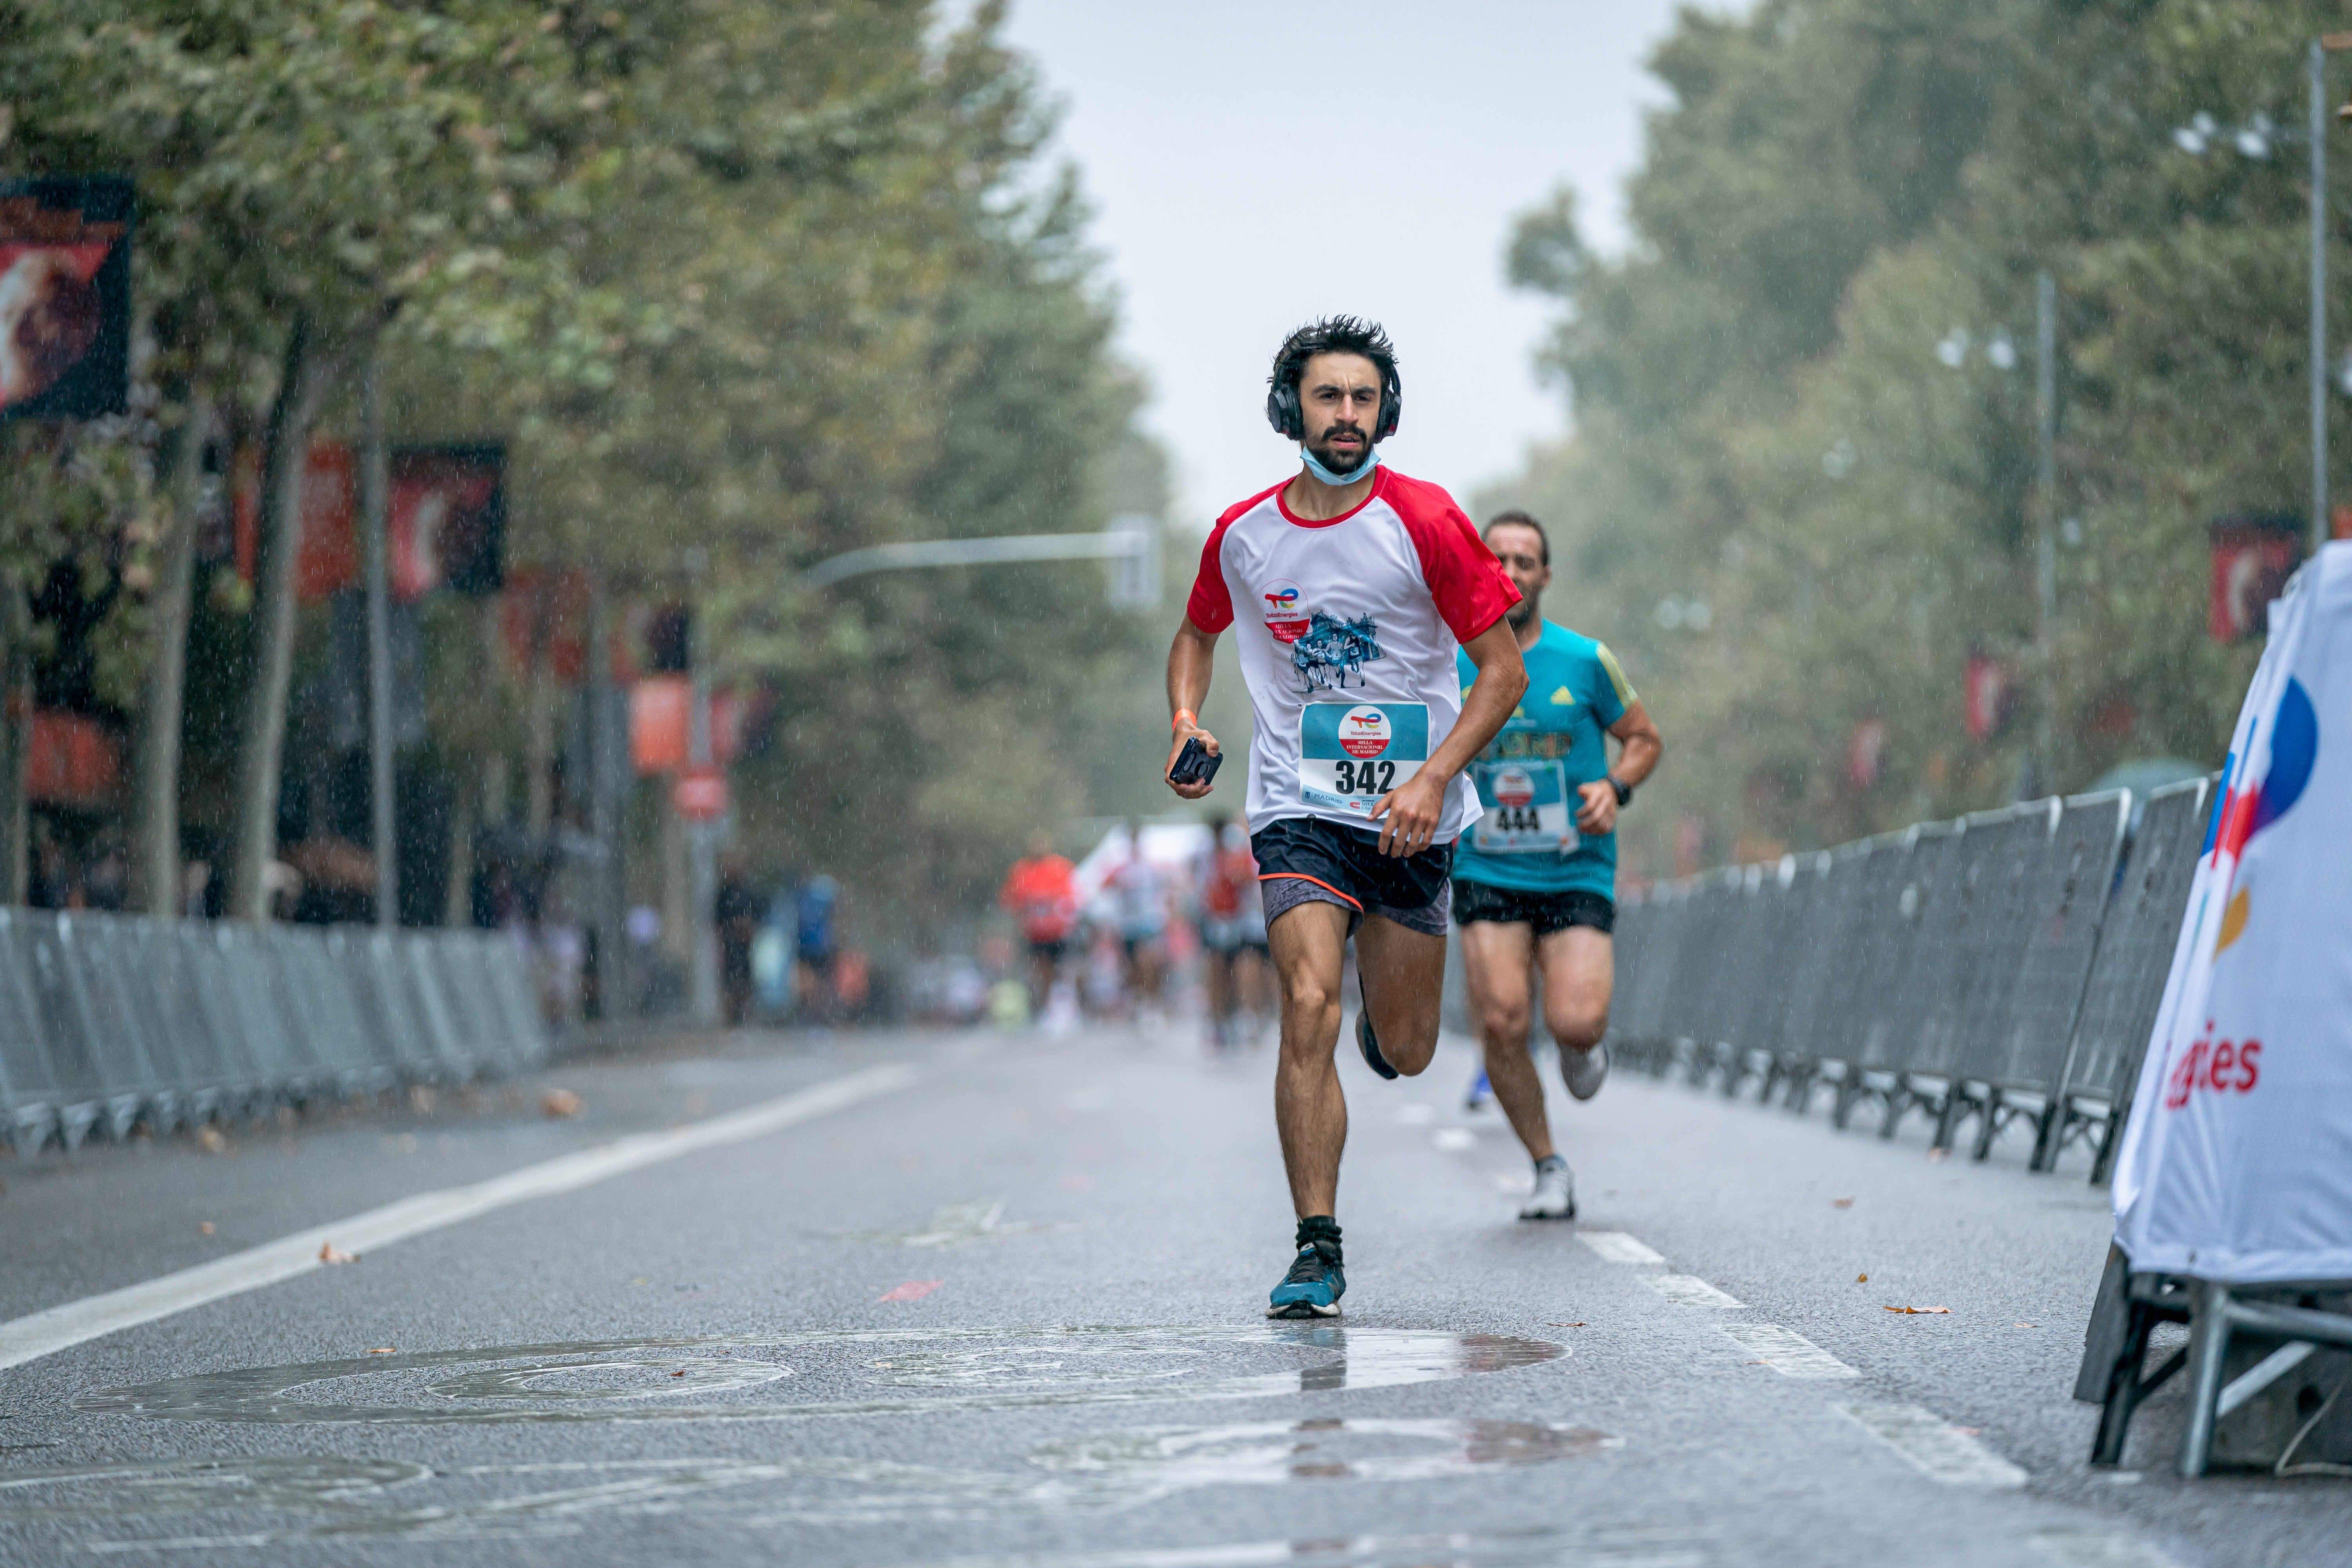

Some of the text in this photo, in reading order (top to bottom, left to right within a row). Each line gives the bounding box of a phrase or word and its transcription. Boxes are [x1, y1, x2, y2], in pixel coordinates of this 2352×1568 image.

[1336, 760, 1395, 794] 342
[1314, 793, 1342, 804] MADRID
[1496, 808, 1539, 831] 444
